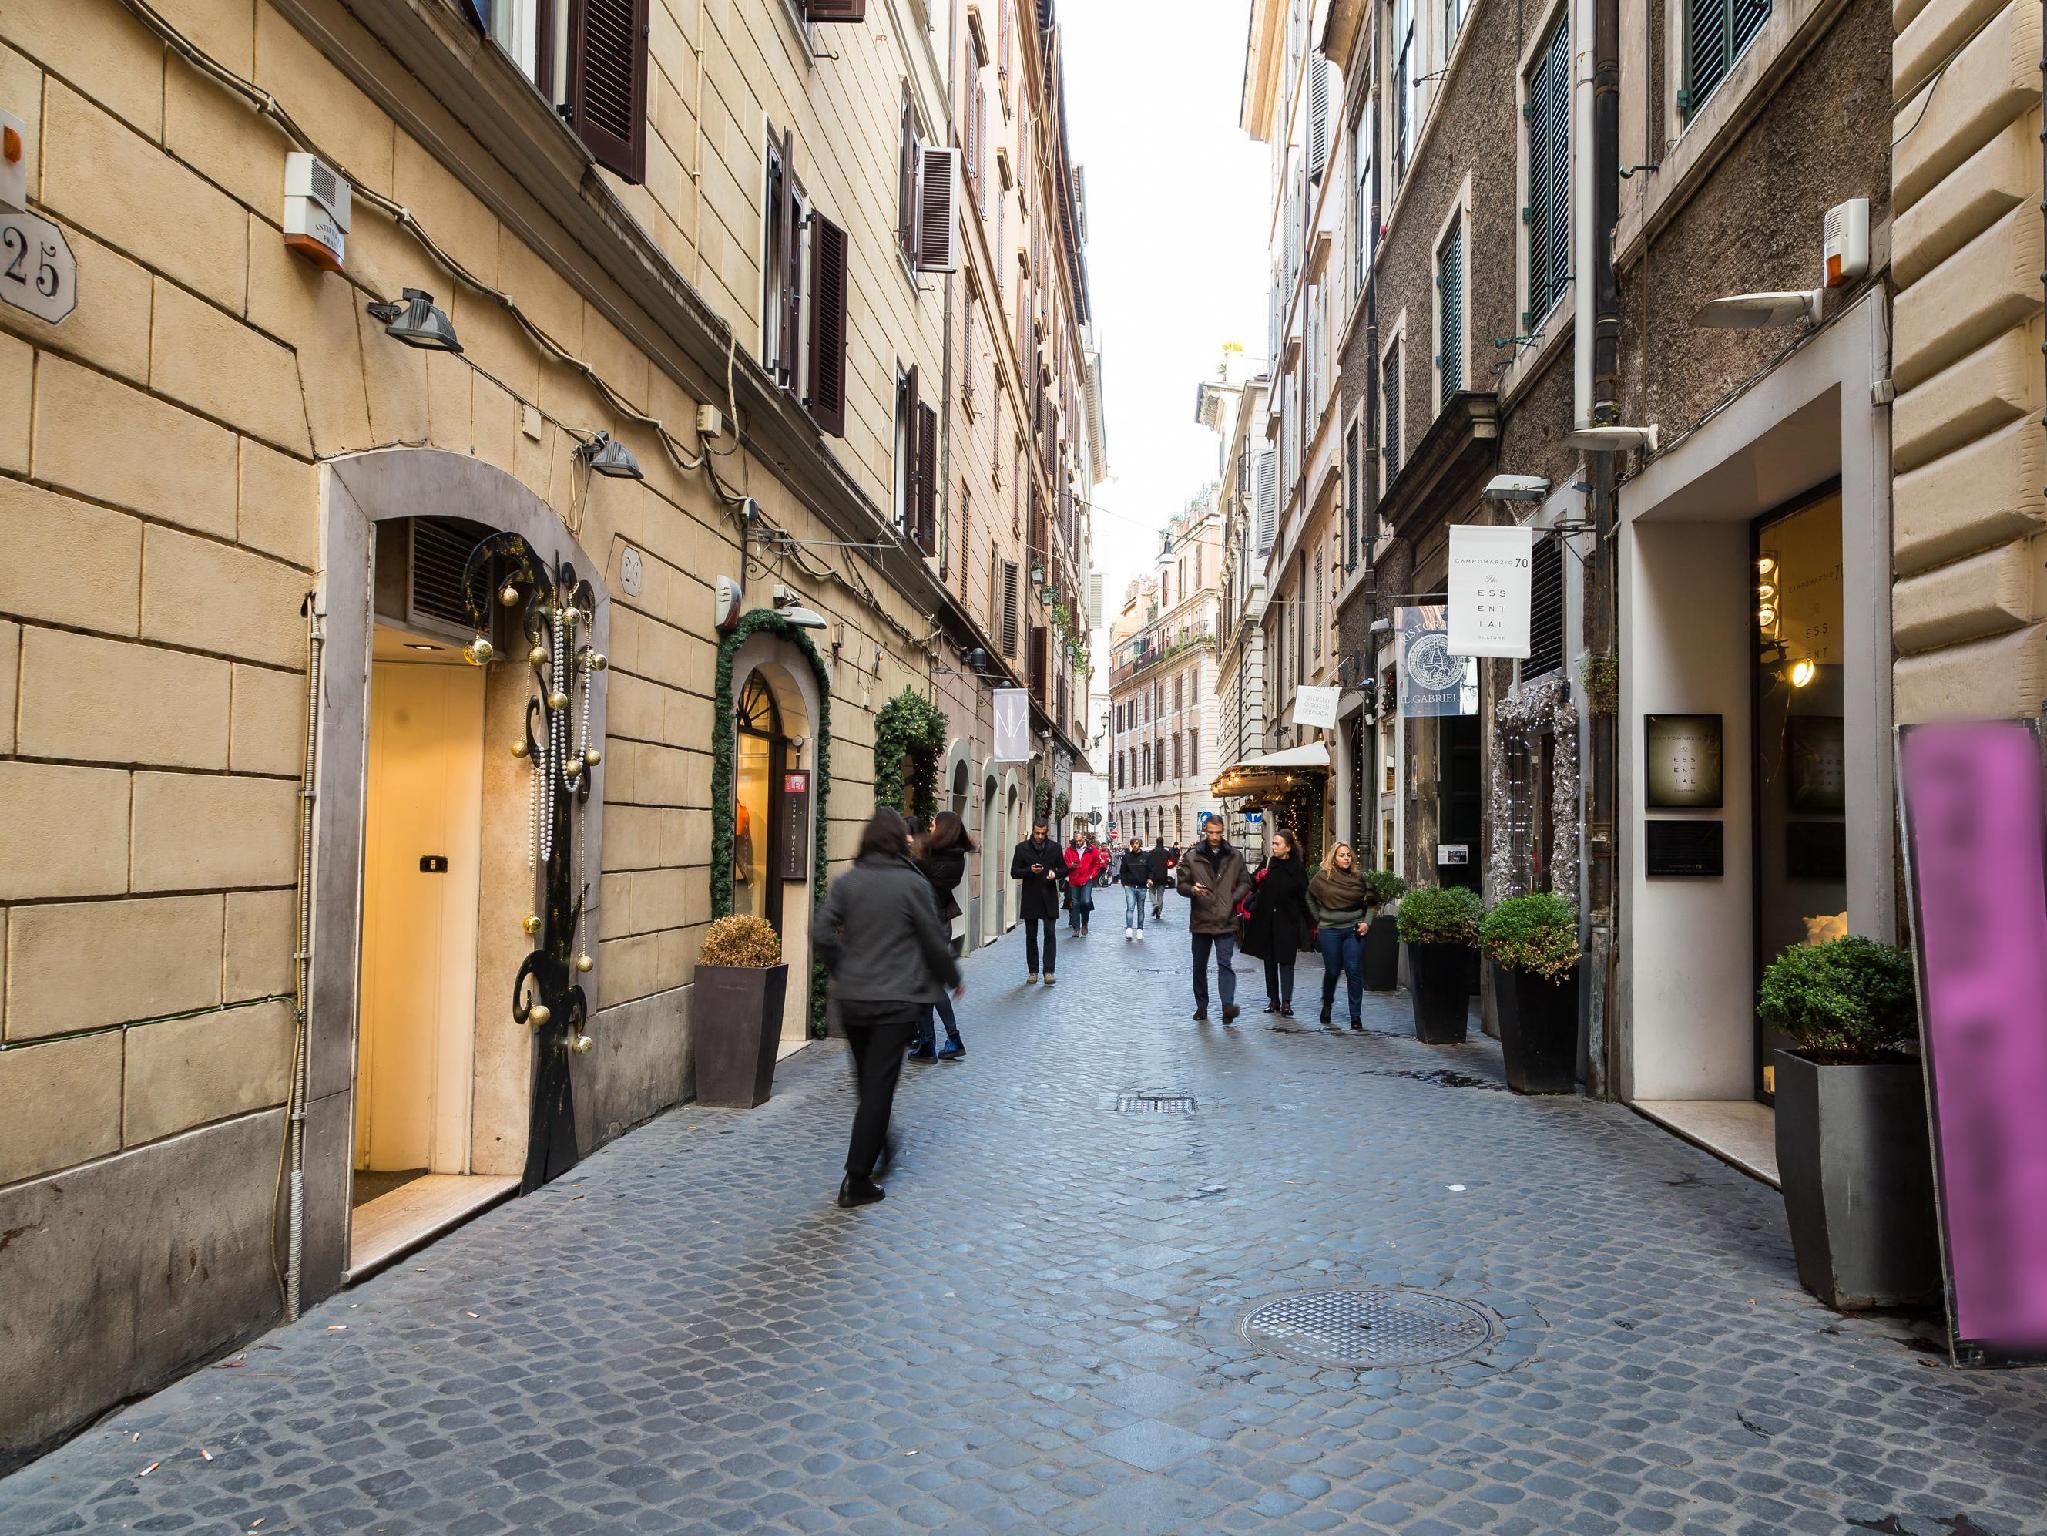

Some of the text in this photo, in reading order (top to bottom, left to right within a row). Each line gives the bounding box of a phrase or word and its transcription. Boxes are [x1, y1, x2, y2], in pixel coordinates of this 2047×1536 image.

[3, 226, 60, 297] 25
[624, 556, 639, 587] 26
[1515, 558, 1529, 568] 70
